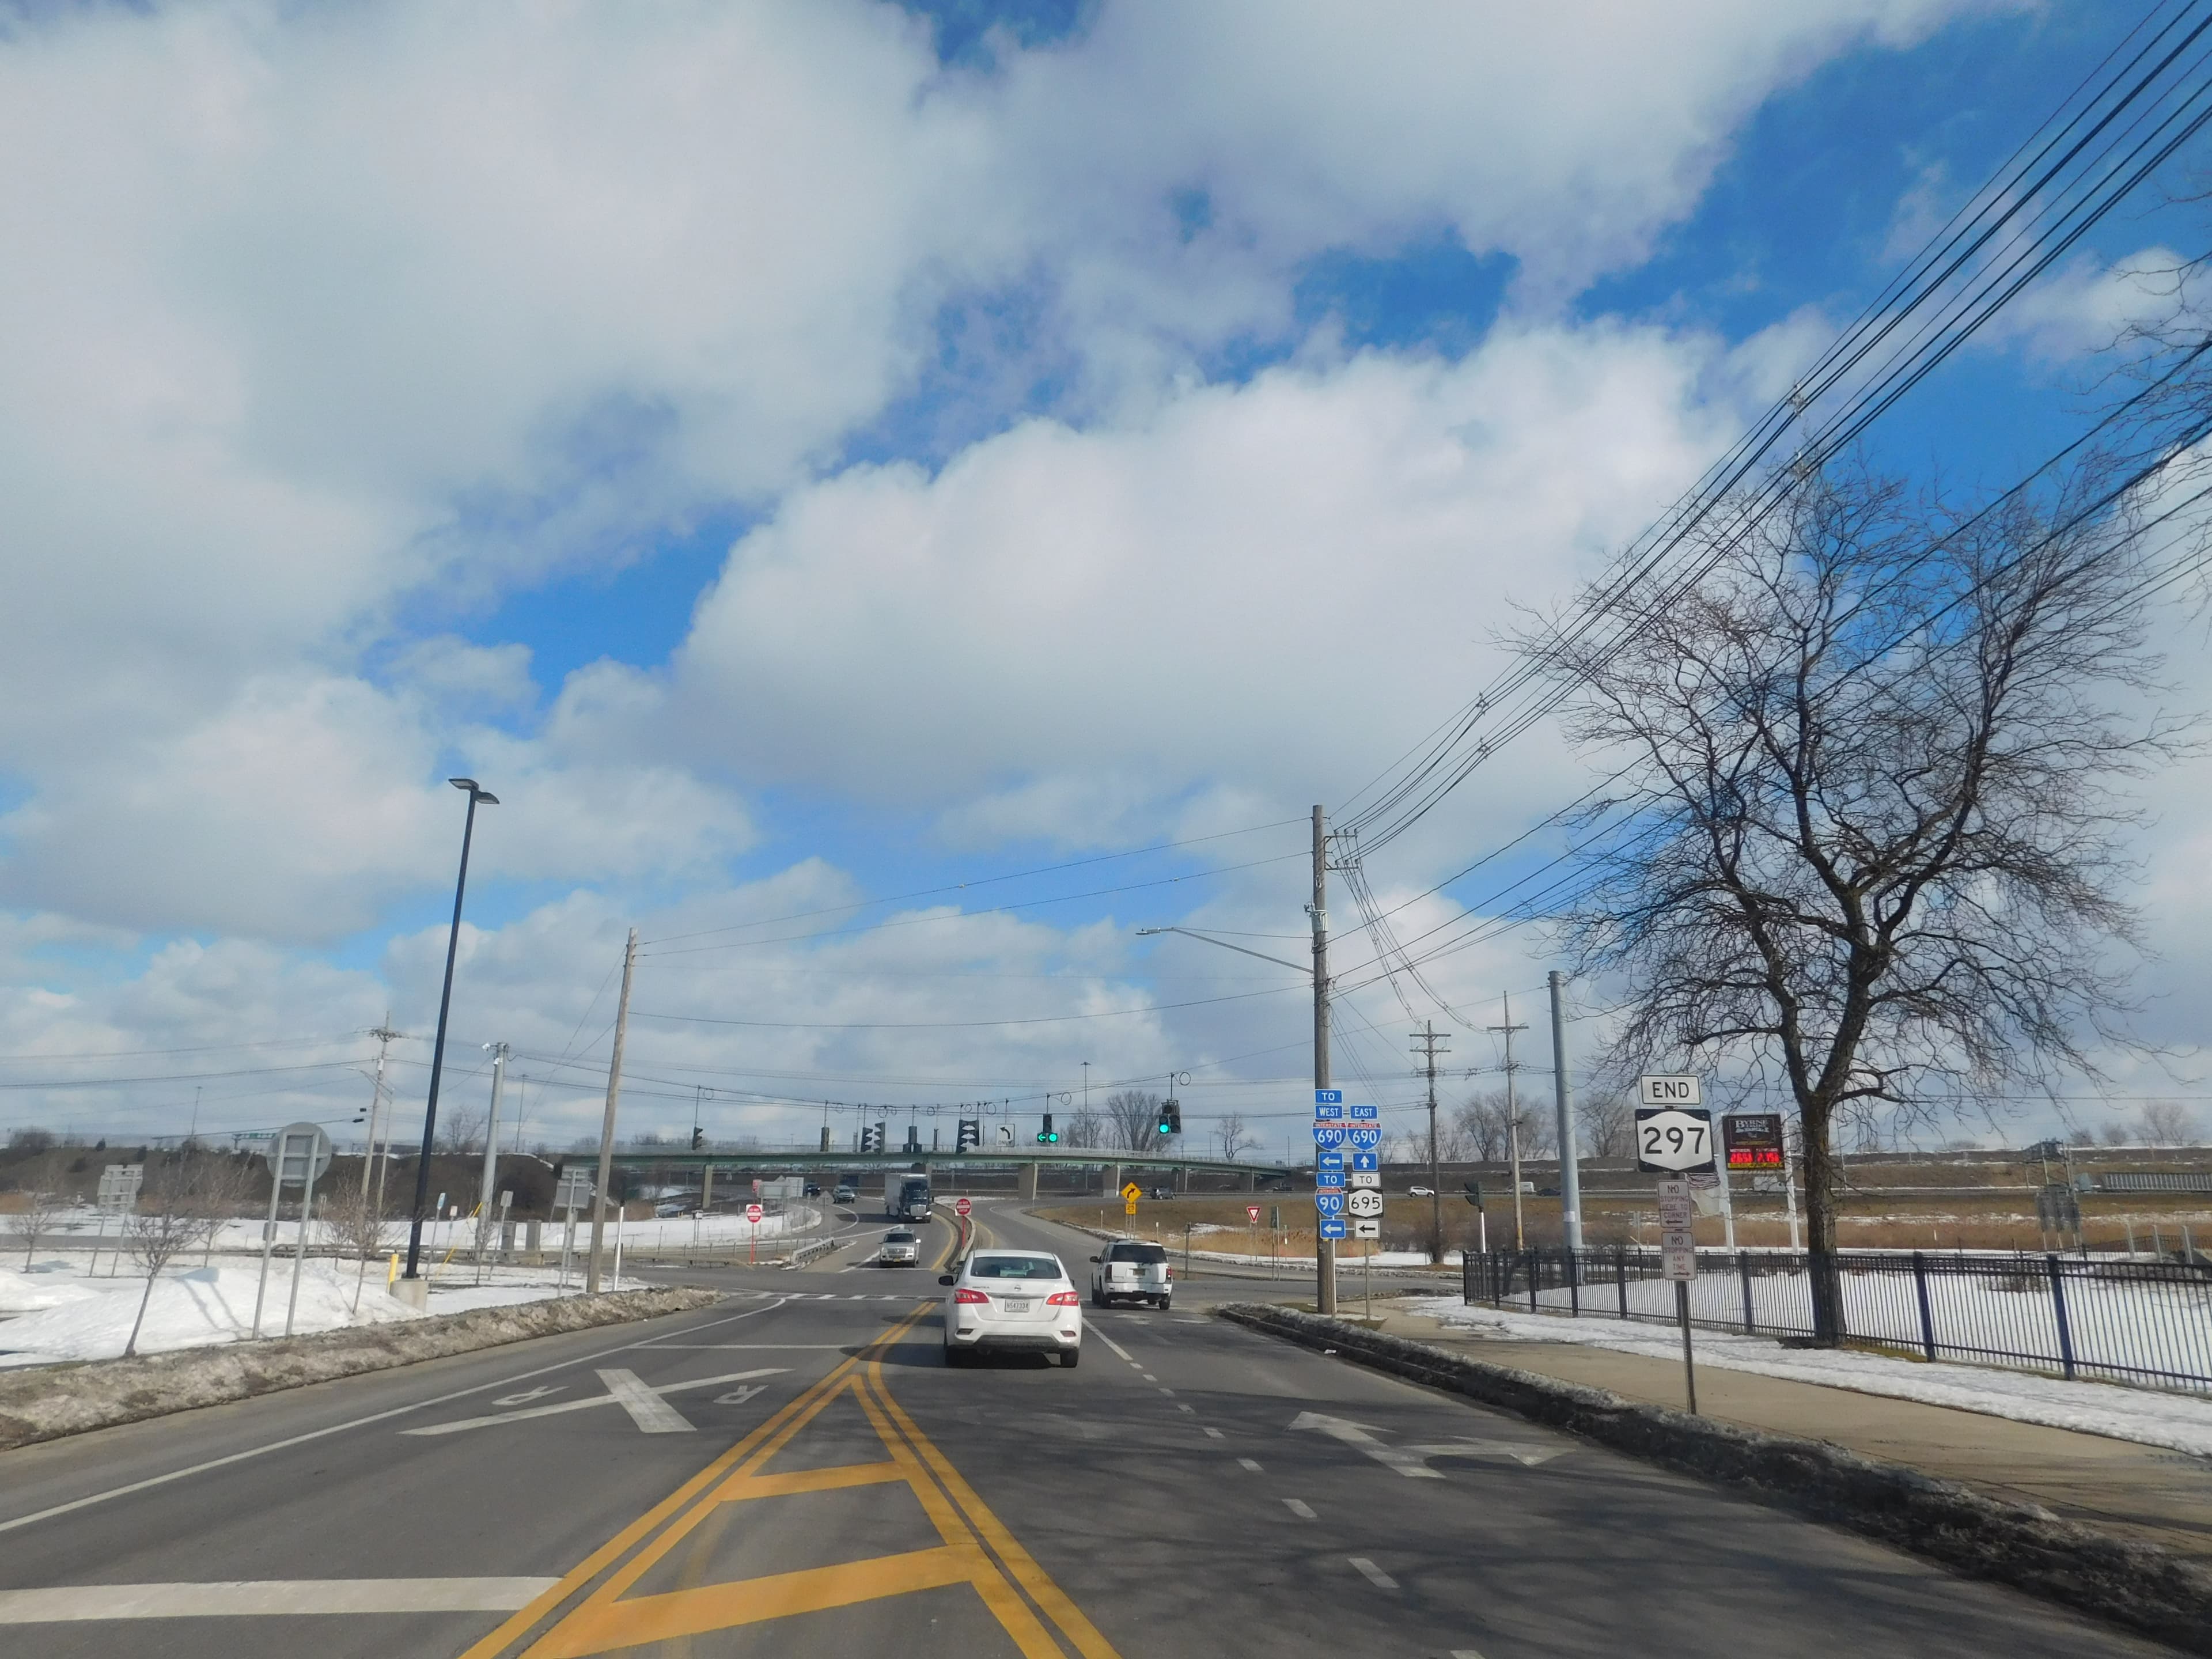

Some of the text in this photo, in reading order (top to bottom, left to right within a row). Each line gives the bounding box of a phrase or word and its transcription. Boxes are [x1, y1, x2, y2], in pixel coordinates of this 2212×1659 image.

[1652, 1082, 1690, 1098] END
[1321, 1092, 1335, 1101] TO
[1319, 1107, 1339, 1116] WEST
[1354, 1107, 1373, 1116] EAST
[1318, 1130, 1342, 1143] 690
[1353, 1130, 1377, 1143] 690
[1643, 1127, 1705, 1154] 297
[1324, 1175, 1337, 1184] TO
[1359, 1176, 1372, 1184] TO
[1668, 1185, 1679, 1194] NO
[1320, 1197, 1339, 1210] 90
[1351, 1196, 1380, 1209] 695
[1672, 1236, 1683, 1245] NO
